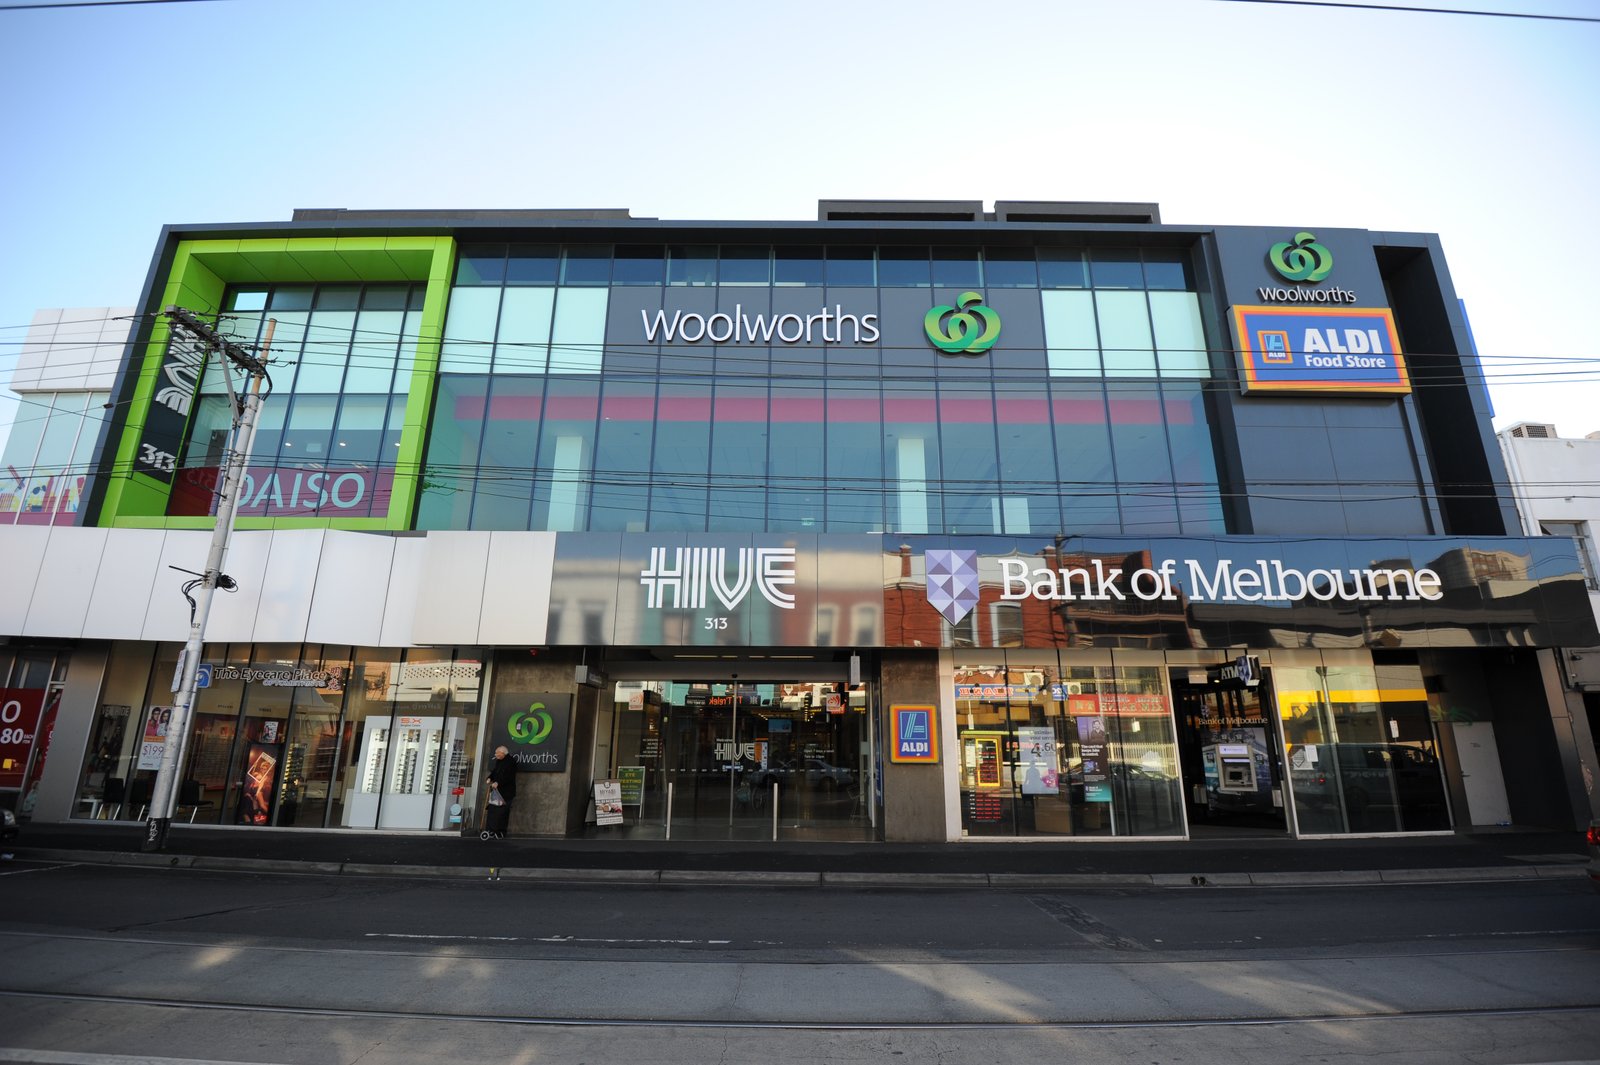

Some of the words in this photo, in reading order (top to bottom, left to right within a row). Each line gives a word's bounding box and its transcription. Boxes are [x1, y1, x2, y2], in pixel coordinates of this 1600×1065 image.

[1259, 286, 1357, 303] Woolworths
[641, 304, 880, 344] Woolworths
[1303, 328, 1384, 354] ALDI
[1304, 354, 1345, 368] Food
[1346, 355, 1386, 369] Store
[139, 443, 177, 473] 313
[640, 547, 796, 611] HIVE
[997, 558, 1123, 601] Bank
[1129, 558, 1176, 601] of
[1182, 558, 1444, 601] Melbourne
[704, 617, 728, 630] 313
[214, 667, 238, 680] The
[240, 667, 291, 683] Eyecare
[292, 668, 327, 680] Place
[1221, 665, 1239, 680] ATM
[714, 742, 755, 761] HIVE
[901, 742, 929, 752] ALDI
[512, 751, 558, 764] olworths
